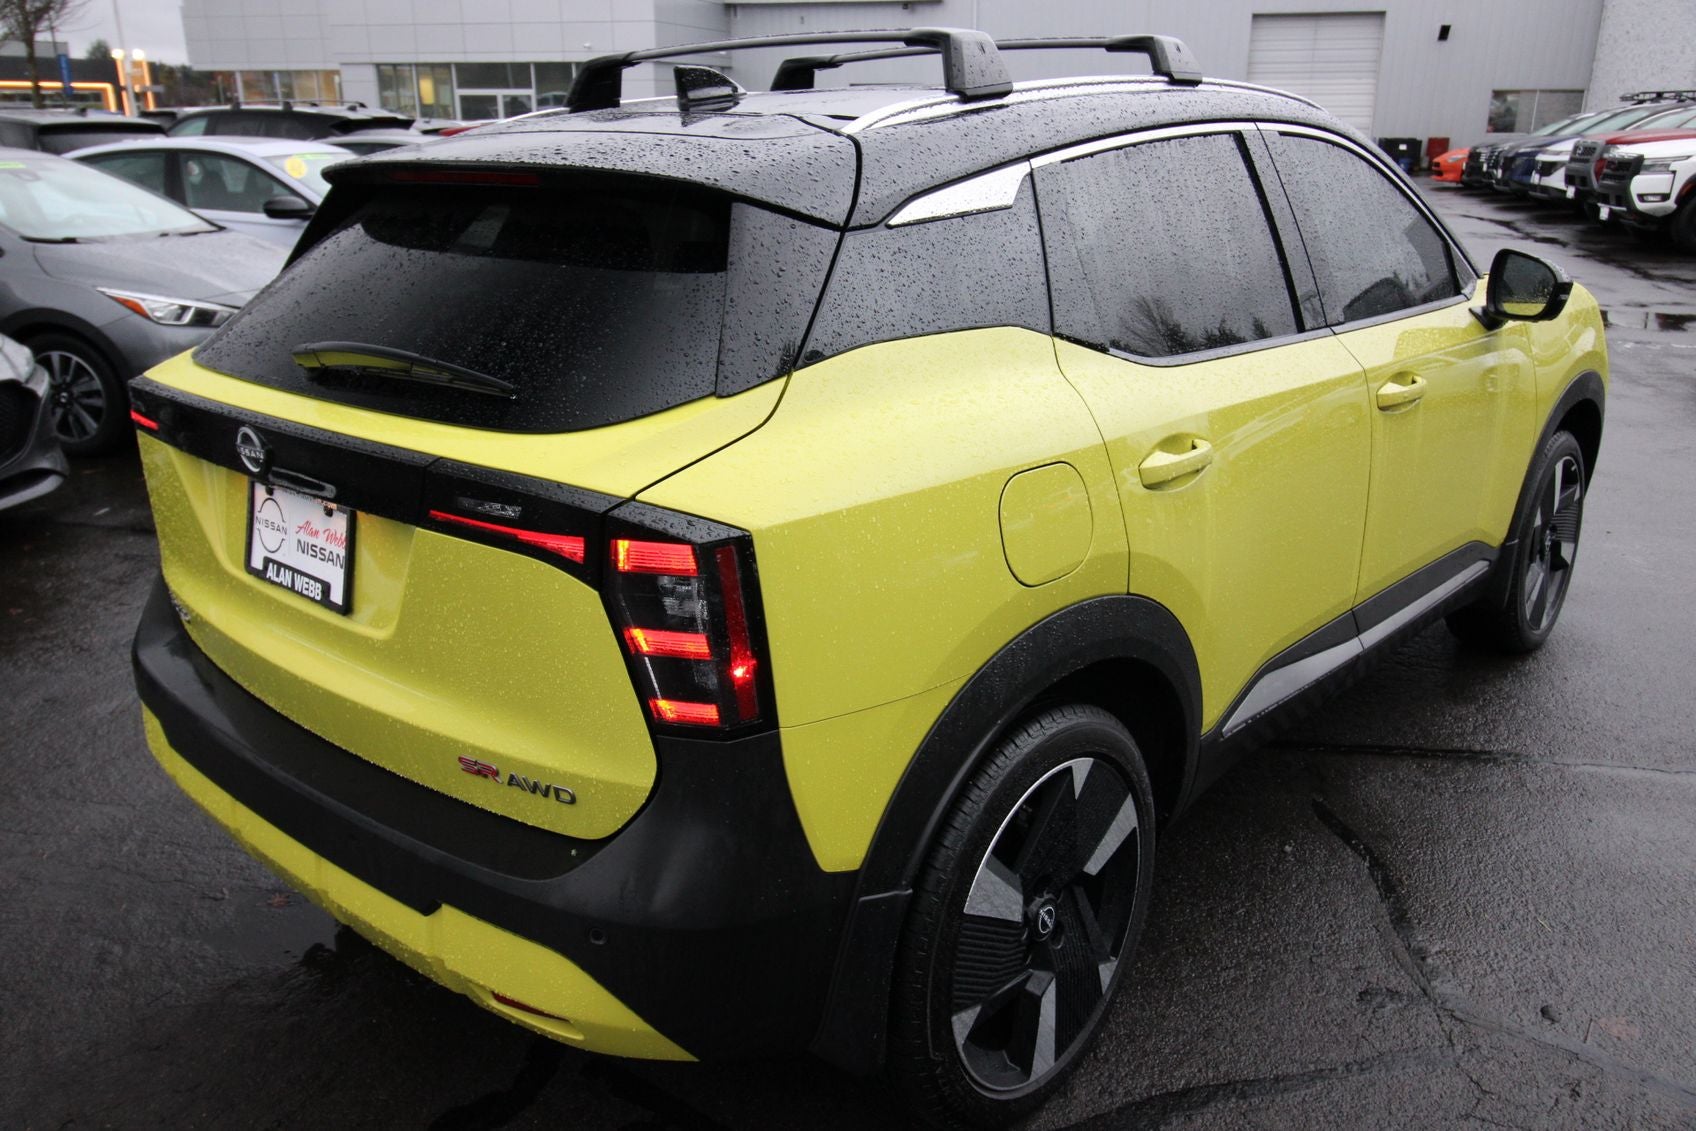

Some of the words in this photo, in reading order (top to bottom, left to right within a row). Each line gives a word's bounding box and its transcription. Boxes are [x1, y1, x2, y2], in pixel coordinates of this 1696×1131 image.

[256, 516, 288, 535] NISSAN
[296, 520, 320, 538] Alan
[296, 539, 345, 569] NISSAN
[266, 563, 291, 588] ALAN
[294, 573, 321, 600] WEBB
[458, 756, 503, 784] SR
[507, 772, 577, 804] AWD
